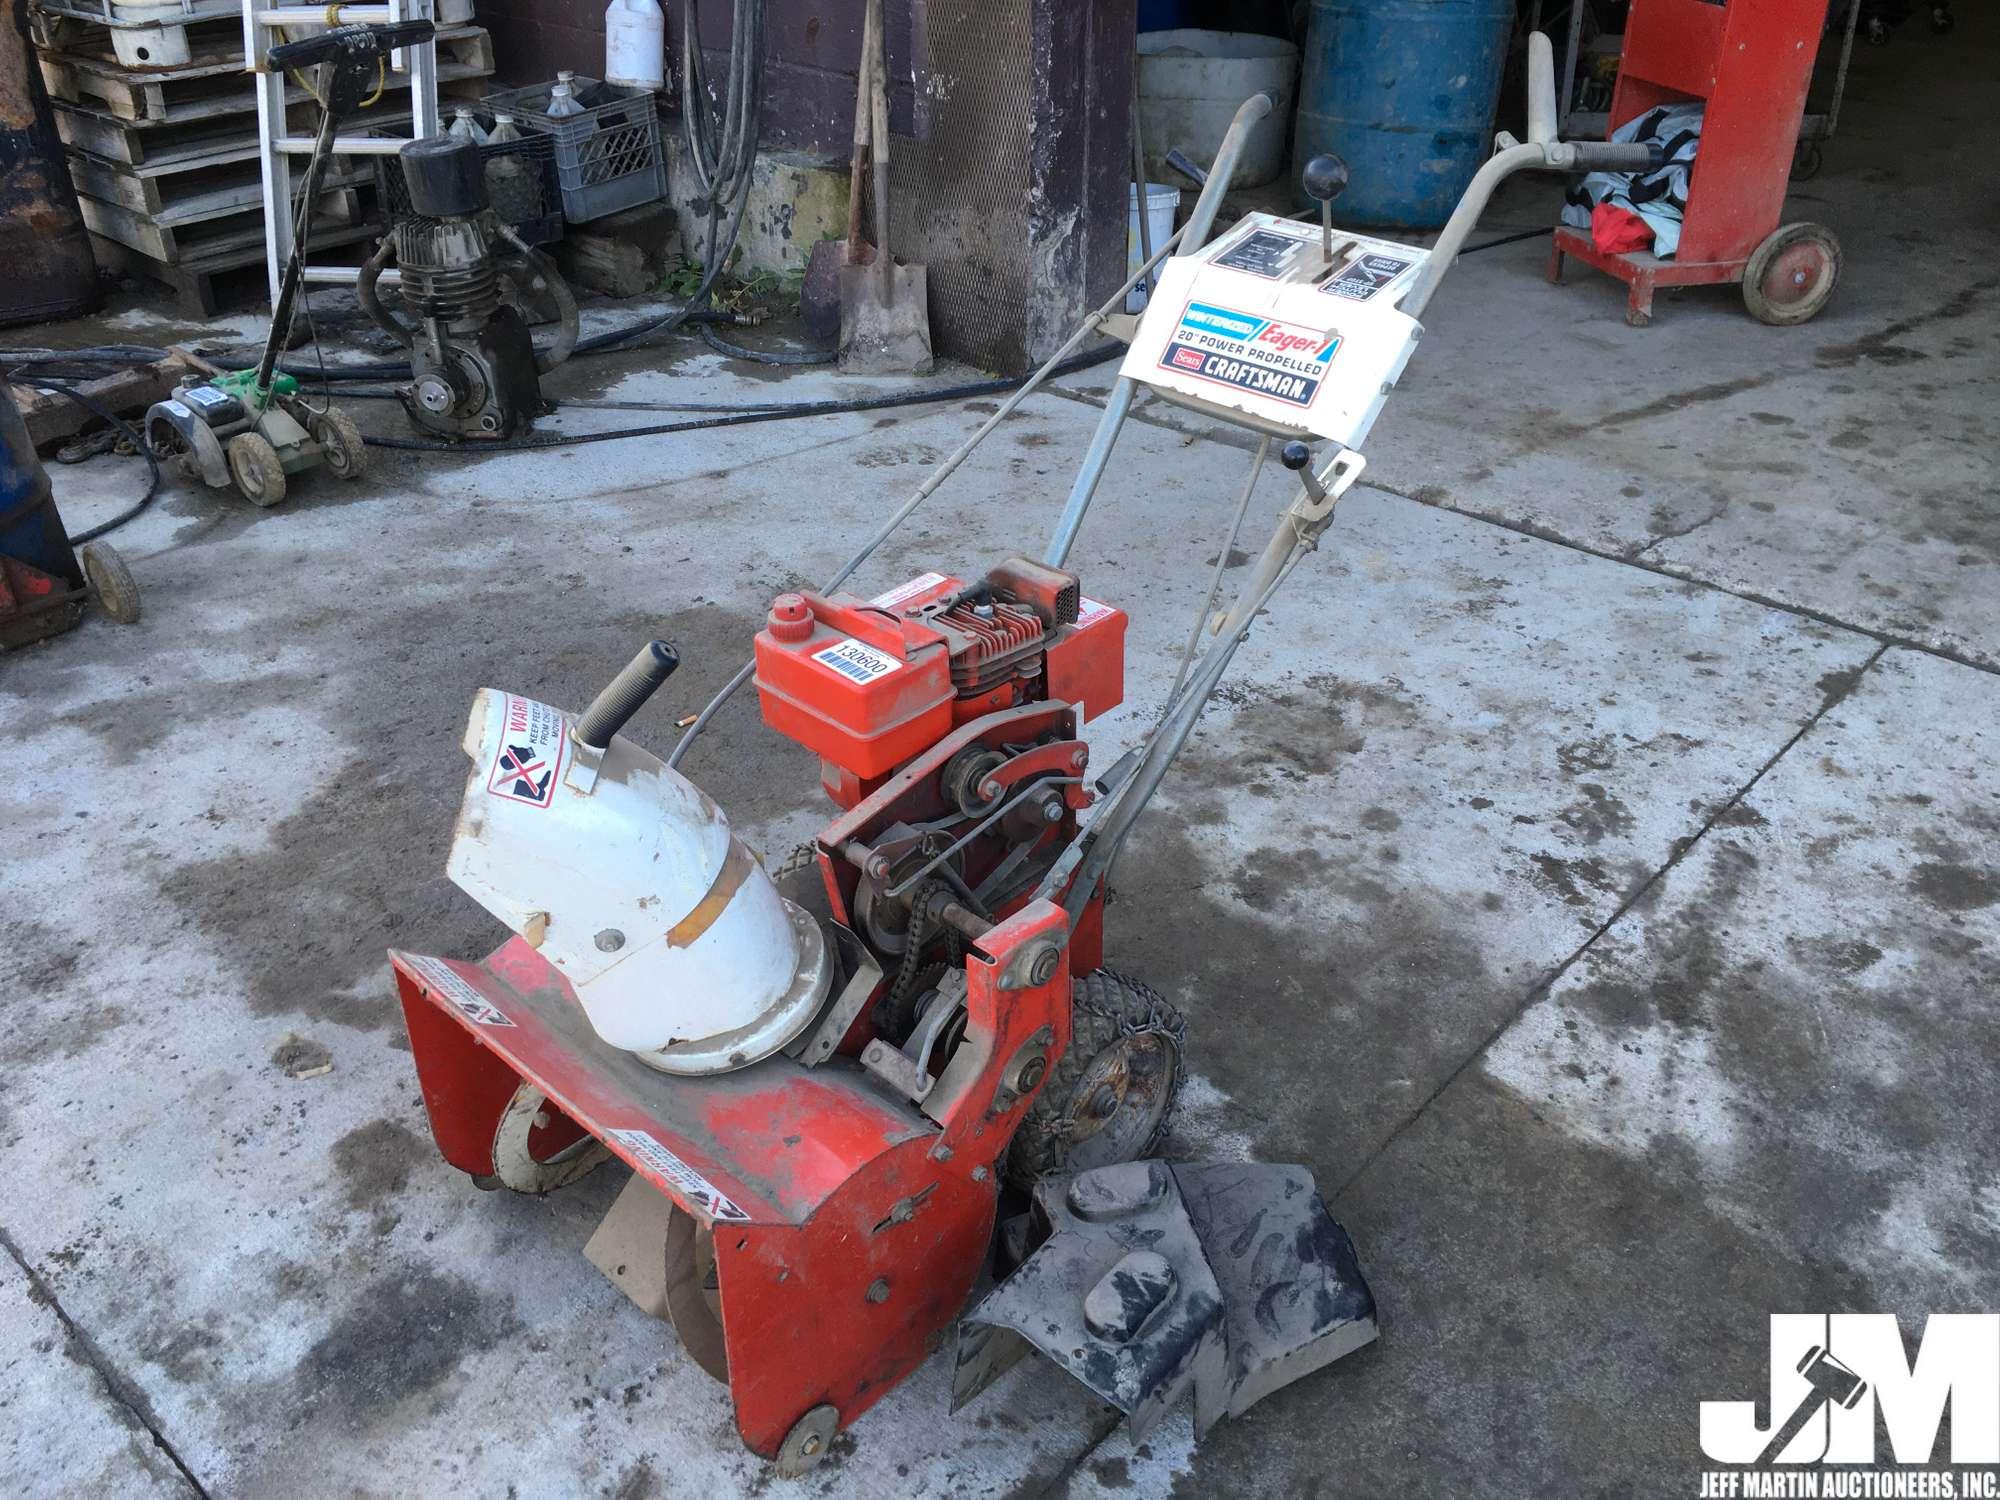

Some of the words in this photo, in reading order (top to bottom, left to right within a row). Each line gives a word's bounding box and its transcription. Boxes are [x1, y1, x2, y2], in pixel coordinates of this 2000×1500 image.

[1199, 335, 1245, 355] POWER
[1248, 348, 1322, 375] PROPELLED
[1259, 323, 1329, 354] Eager-1
[1175, 351, 1201, 367] Sears
[1205, 356, 1306, 399] CRAFTSMAN
[836, 644, 888, 673] 130600
